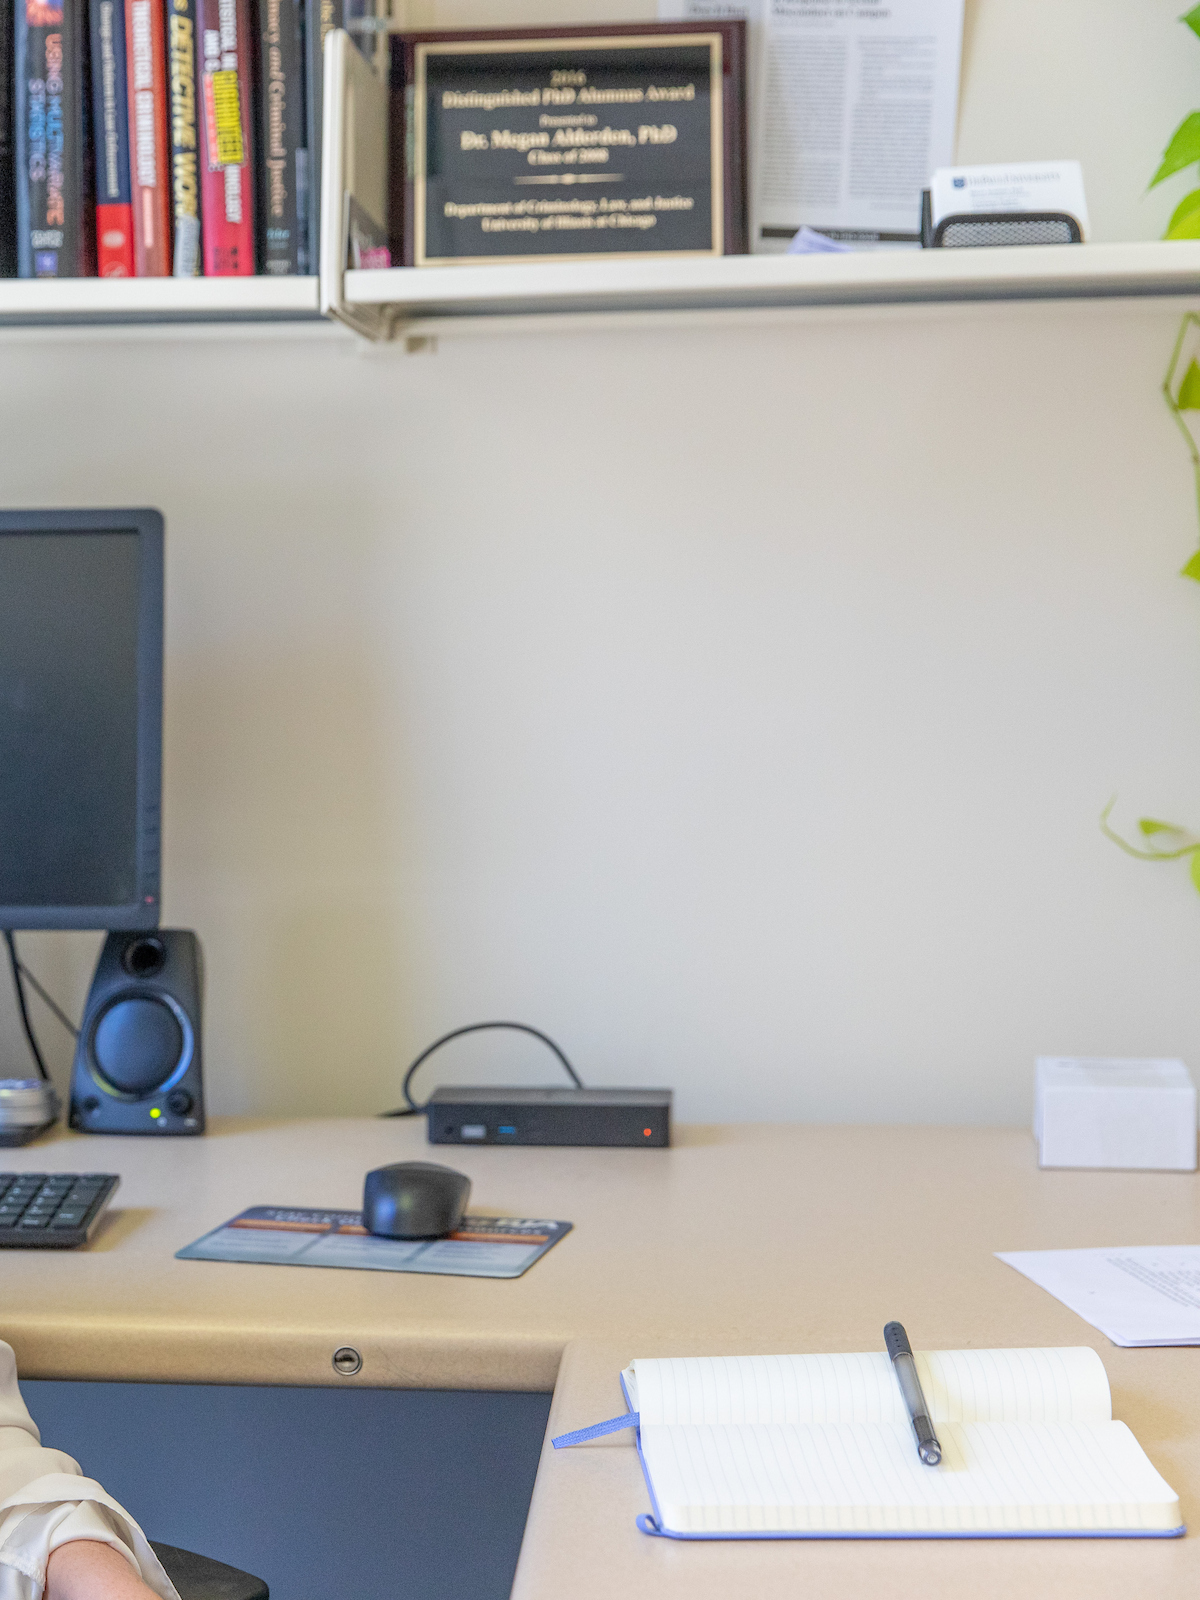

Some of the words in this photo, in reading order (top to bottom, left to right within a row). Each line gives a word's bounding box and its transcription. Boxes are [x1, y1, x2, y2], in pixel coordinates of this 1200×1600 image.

[46, 33, 63, 95] USING
[131, 1, 153, 90] THEORETICAL
[269, 46, 286, 81] and
[170, 13, 196, 149] DETECTIVE
[442, 88, 540, 110] Distinguished
[542, 87, 576, 105] PhD
[645, 83, 695, 101] Award
[28, 78, 46, 182] STATISTICS
[135, 91, 156, 188] CRIMINOLOGY
[268, 81, 287, 157] Criminal
[460, 130, 489, 150] Dr.
[490, 129, 550, 152] Megan
[638, 124, 678, 144] PhD
[46, 96, 64, 226] MULTIVARIATE
[527, 149, 562, 165] Class
[563, 148, 578, 164] of
[266, 159, 288, 217] Justice
[444, 201, 512, 219] Department
[513, 200, 527, 215] of
[599, 197, 628, 213] Law,
[629, 196, 653, 211] and
[654, 195, 694, 211] Justice
[481, 216, 539, 233] University
[540, 215, 554, 230] of
[554, 214, 595, 229] Illinois
[595, 214, 608, 229] at
[608, 213, 657, 230] Chicago
